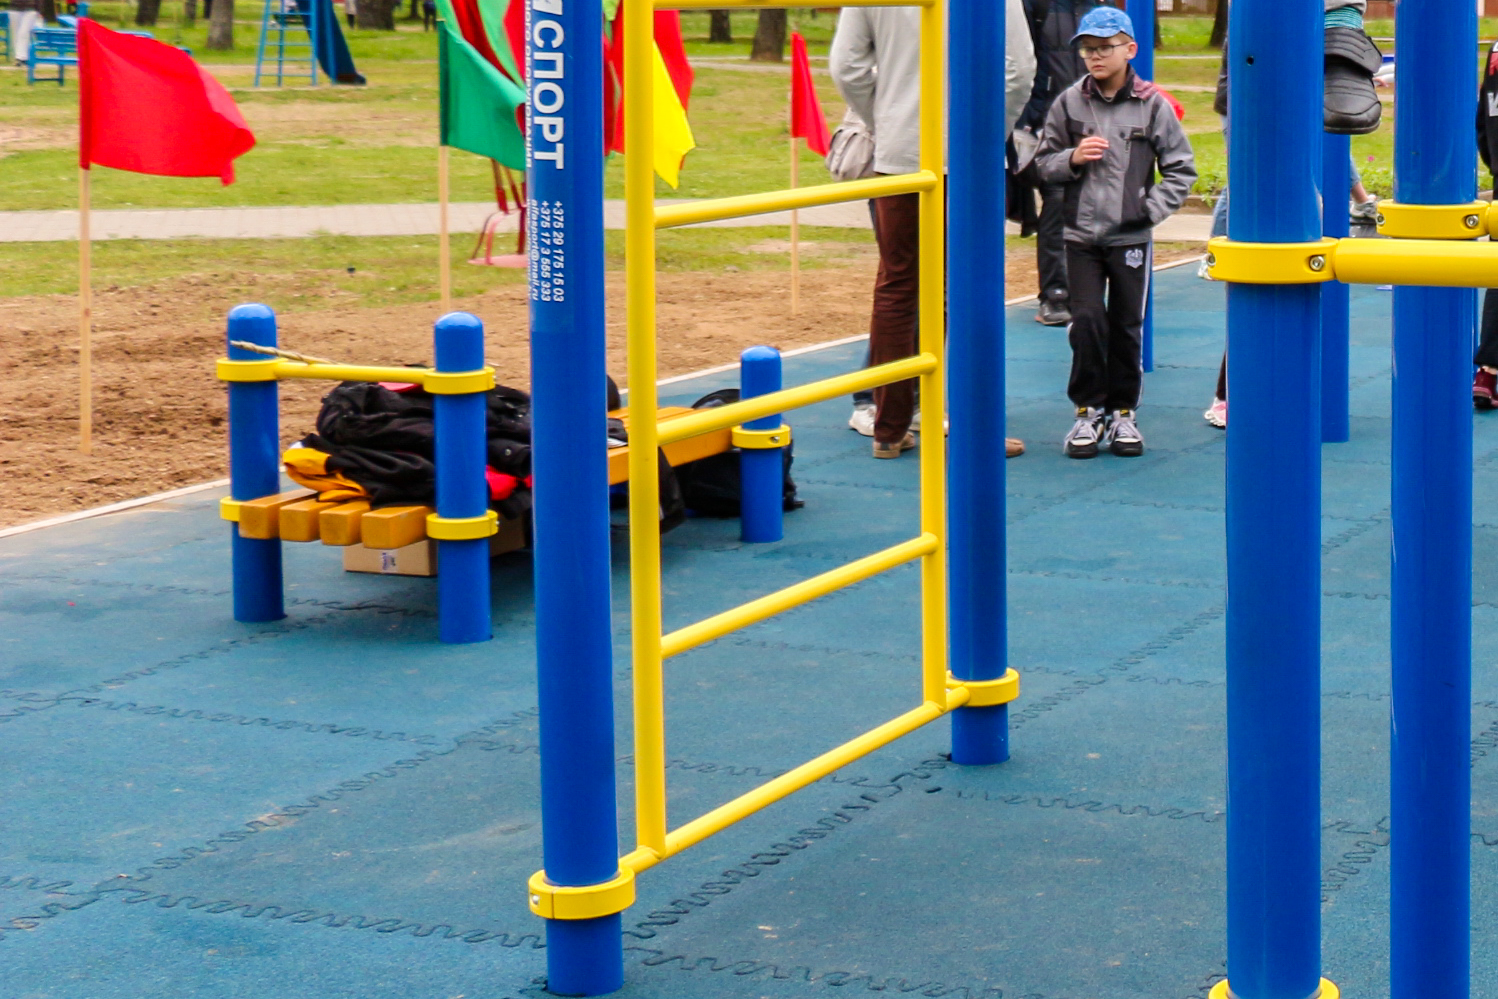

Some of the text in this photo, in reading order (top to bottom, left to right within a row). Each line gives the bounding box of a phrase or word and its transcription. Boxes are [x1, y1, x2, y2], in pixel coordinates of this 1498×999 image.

[553, 201, 565, 229] +375
[540, 201, 551, 302] +375 17 3 555 333
[553, 248, 565, 269] 175
[553, 271, 565, 285] 15
[553, 287, 565, 302] 03
